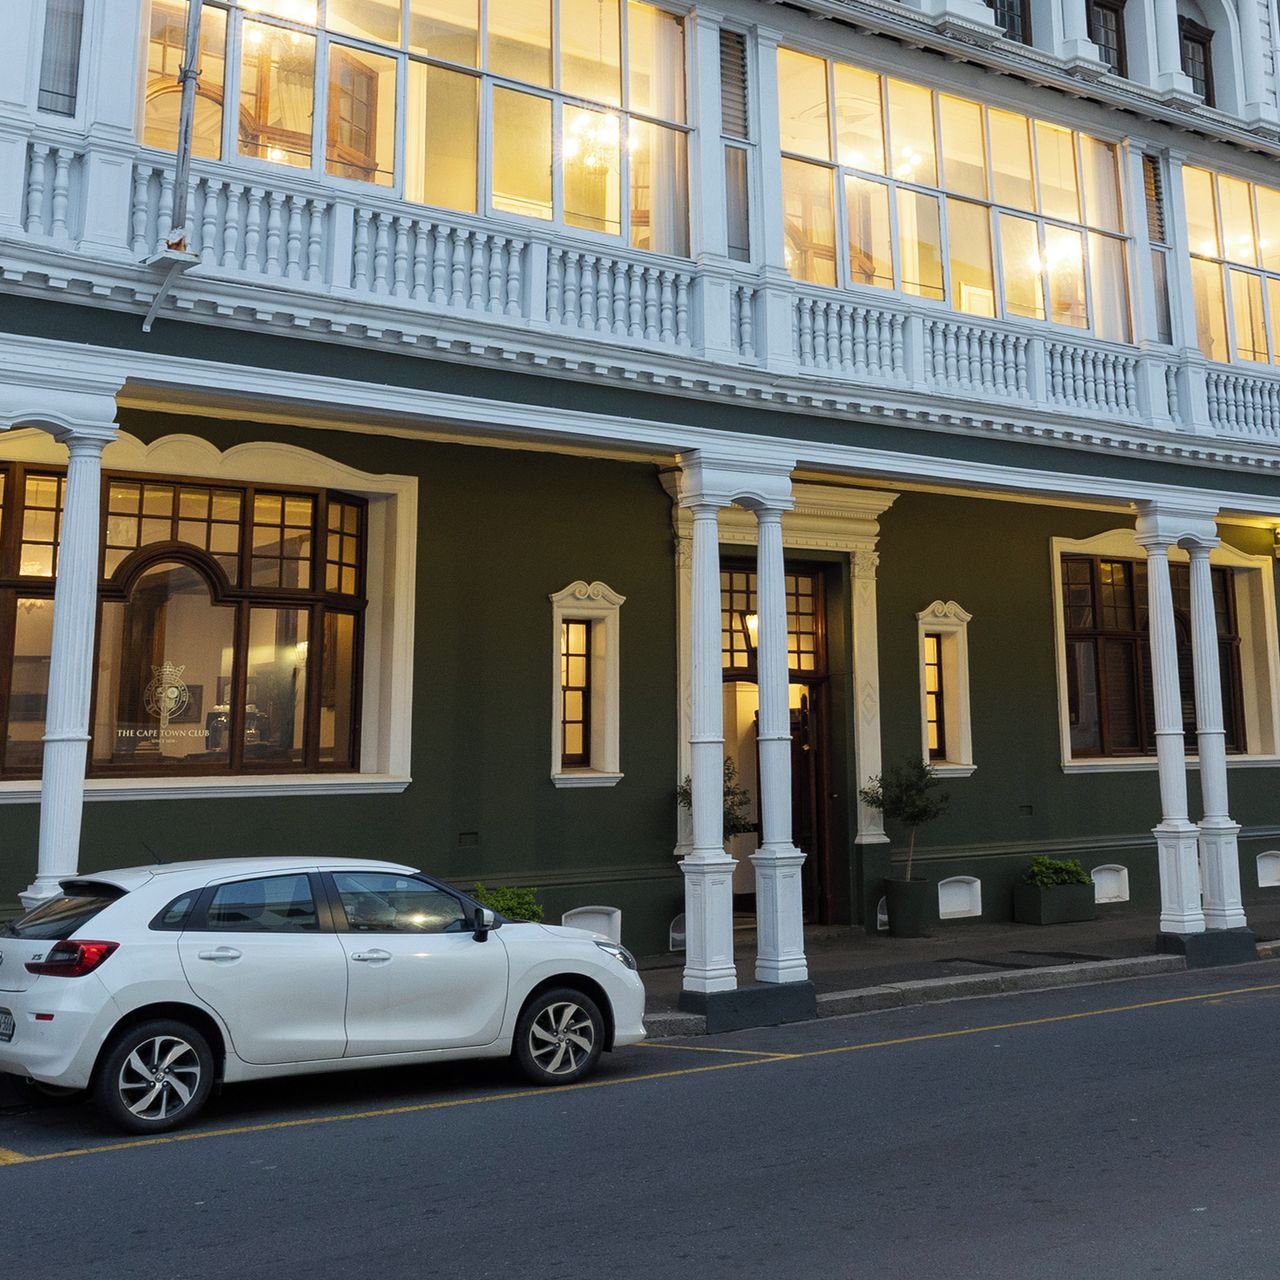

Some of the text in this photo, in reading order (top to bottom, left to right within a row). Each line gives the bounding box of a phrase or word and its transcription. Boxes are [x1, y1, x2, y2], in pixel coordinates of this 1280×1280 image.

[117, 729, 210, 737] THE CAPE TOWN CLUB
